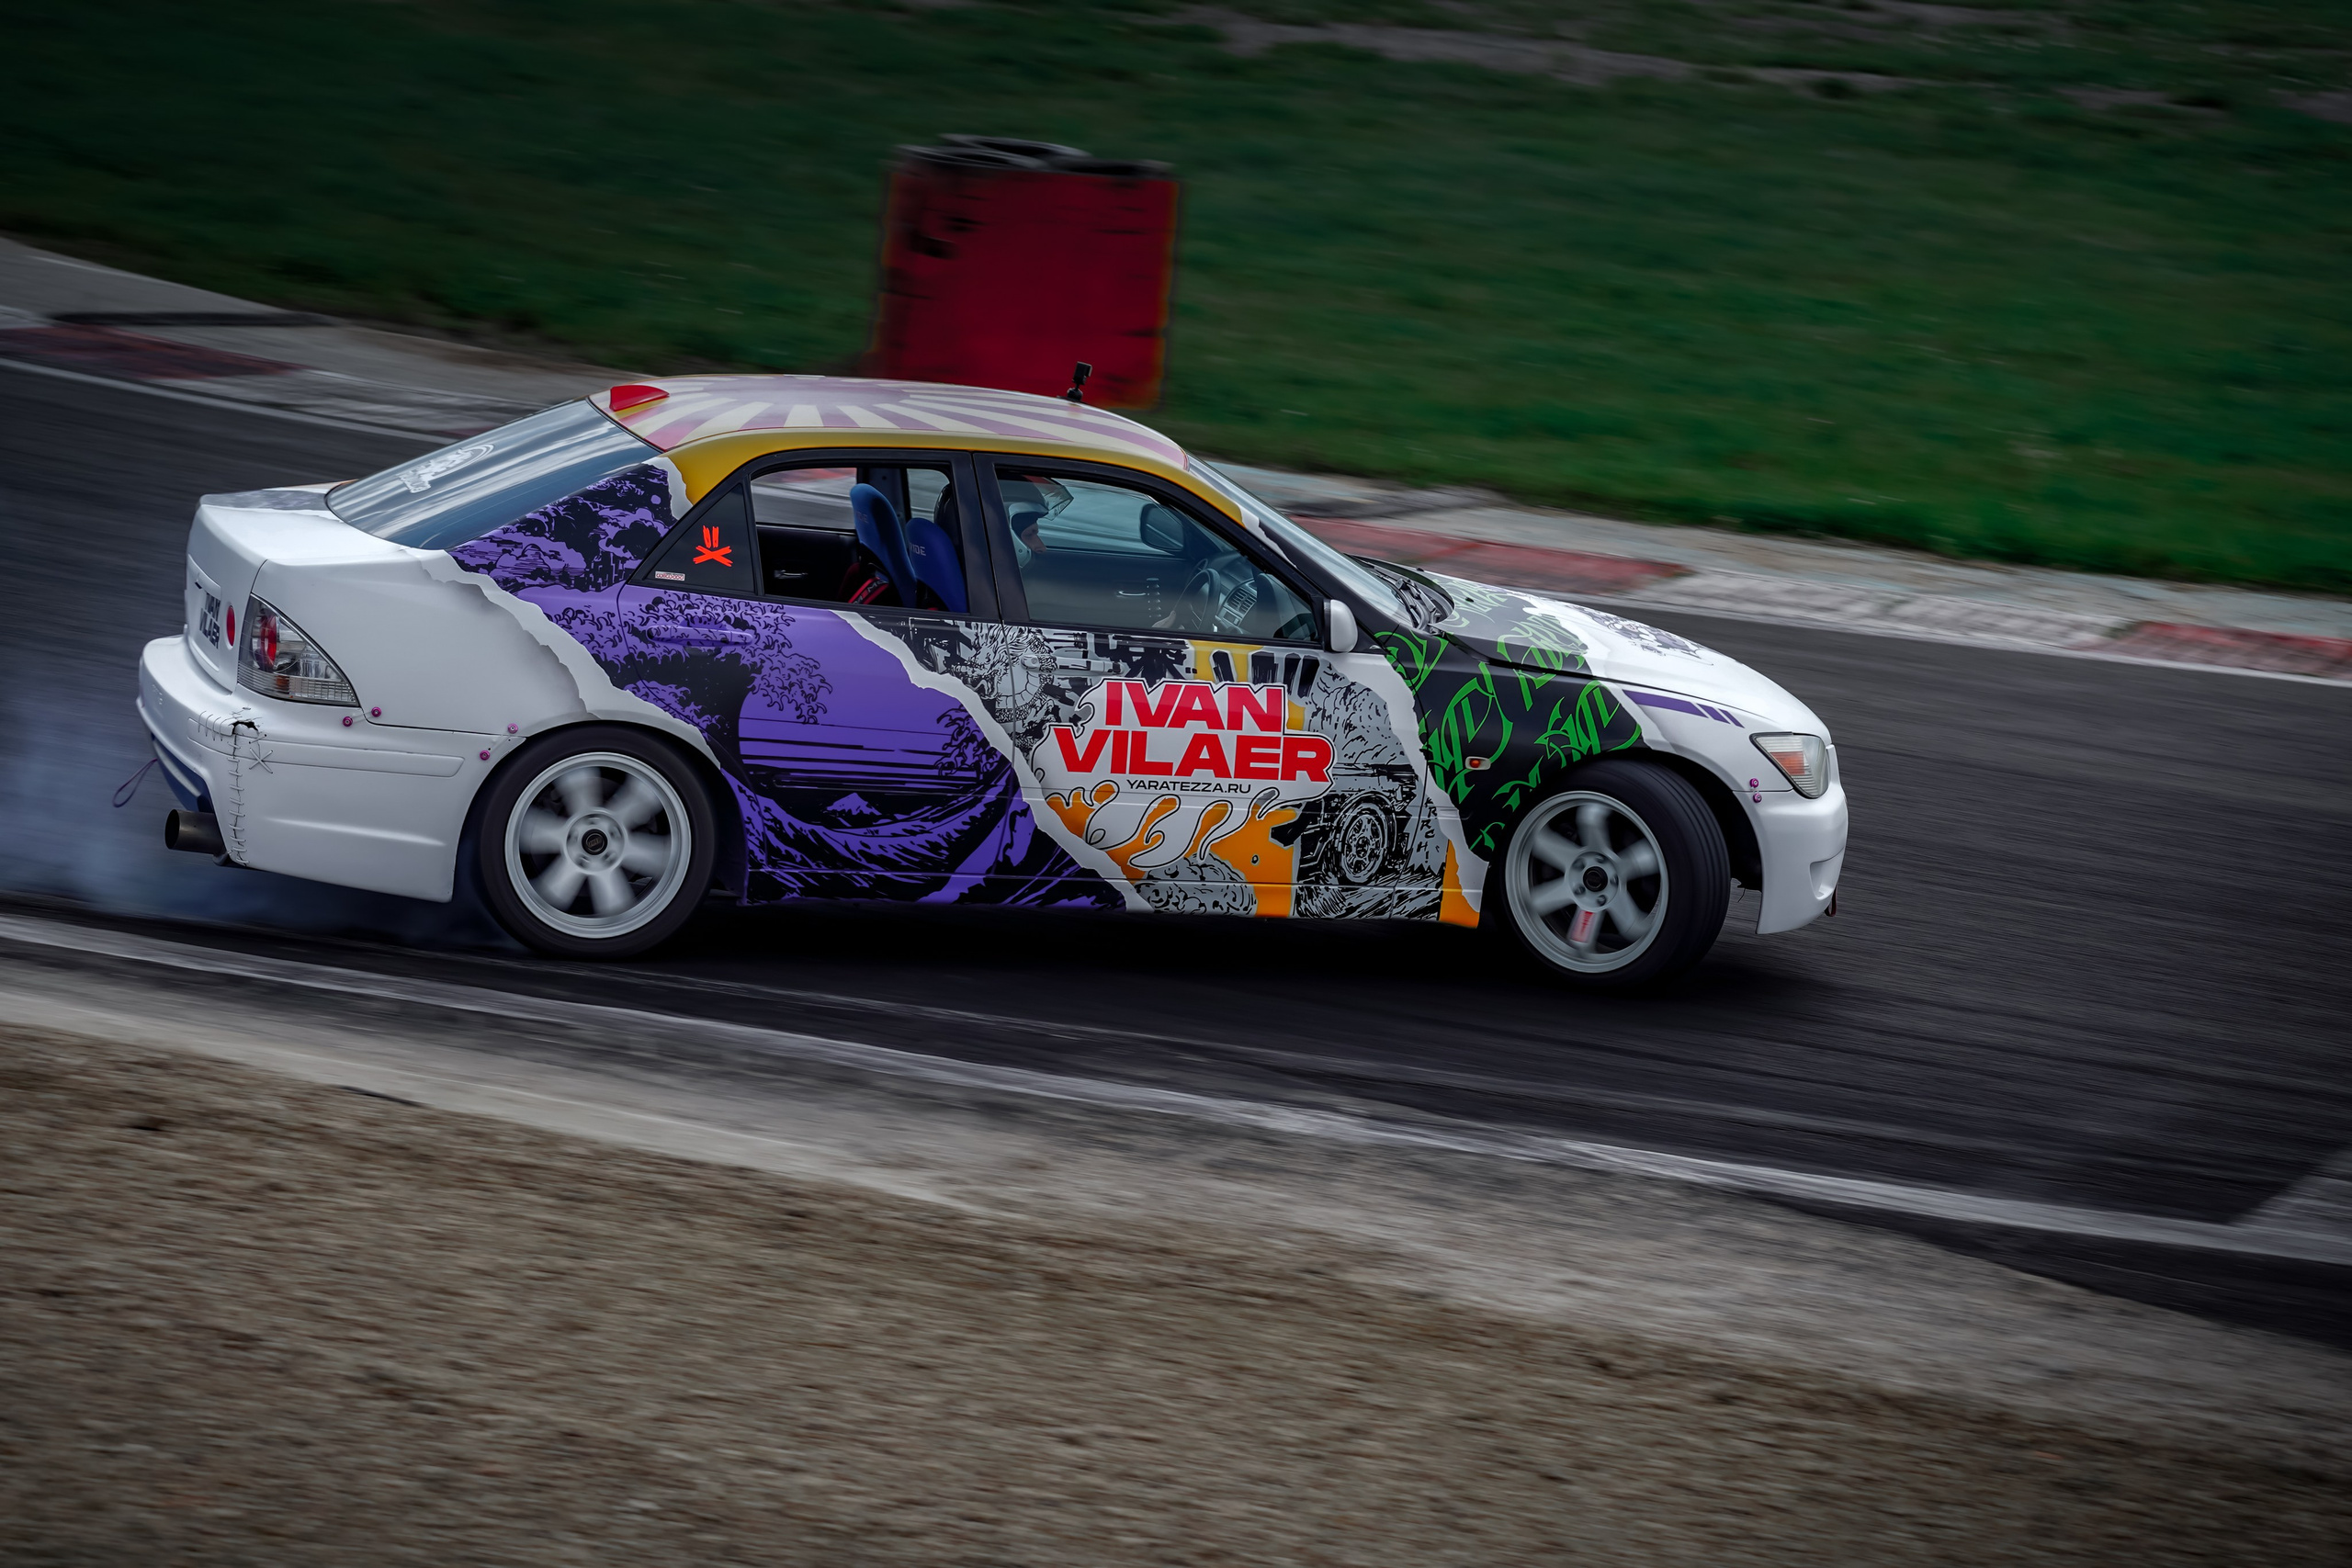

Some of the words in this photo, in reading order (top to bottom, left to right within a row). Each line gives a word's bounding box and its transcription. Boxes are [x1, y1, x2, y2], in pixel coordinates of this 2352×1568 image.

[1105, 682, 1283, 732] IVAN
[1053, 729, 1332, 782] VILAER
[1126, 779, 1251, 794] YARATEZZA.RU
